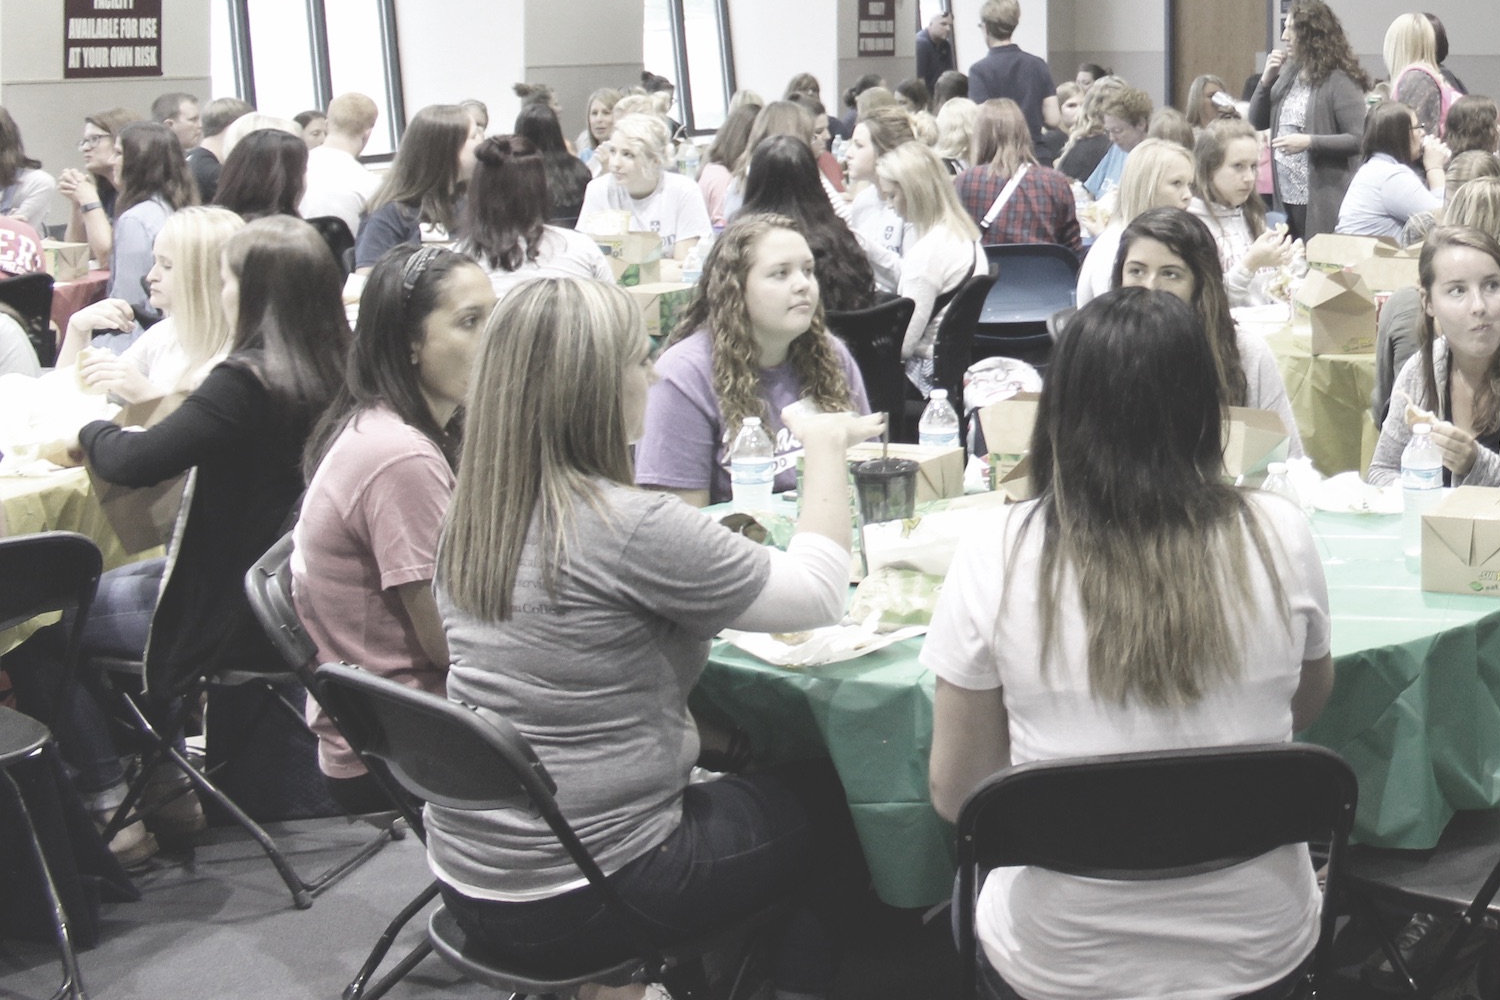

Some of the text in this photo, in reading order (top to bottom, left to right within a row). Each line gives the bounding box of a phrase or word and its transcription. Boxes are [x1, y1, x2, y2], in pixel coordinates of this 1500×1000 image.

[68, 17, 157, 39] AVAILABLE FOR USE
[68, 45, 157, 69] AT YOUR OWN RISK
